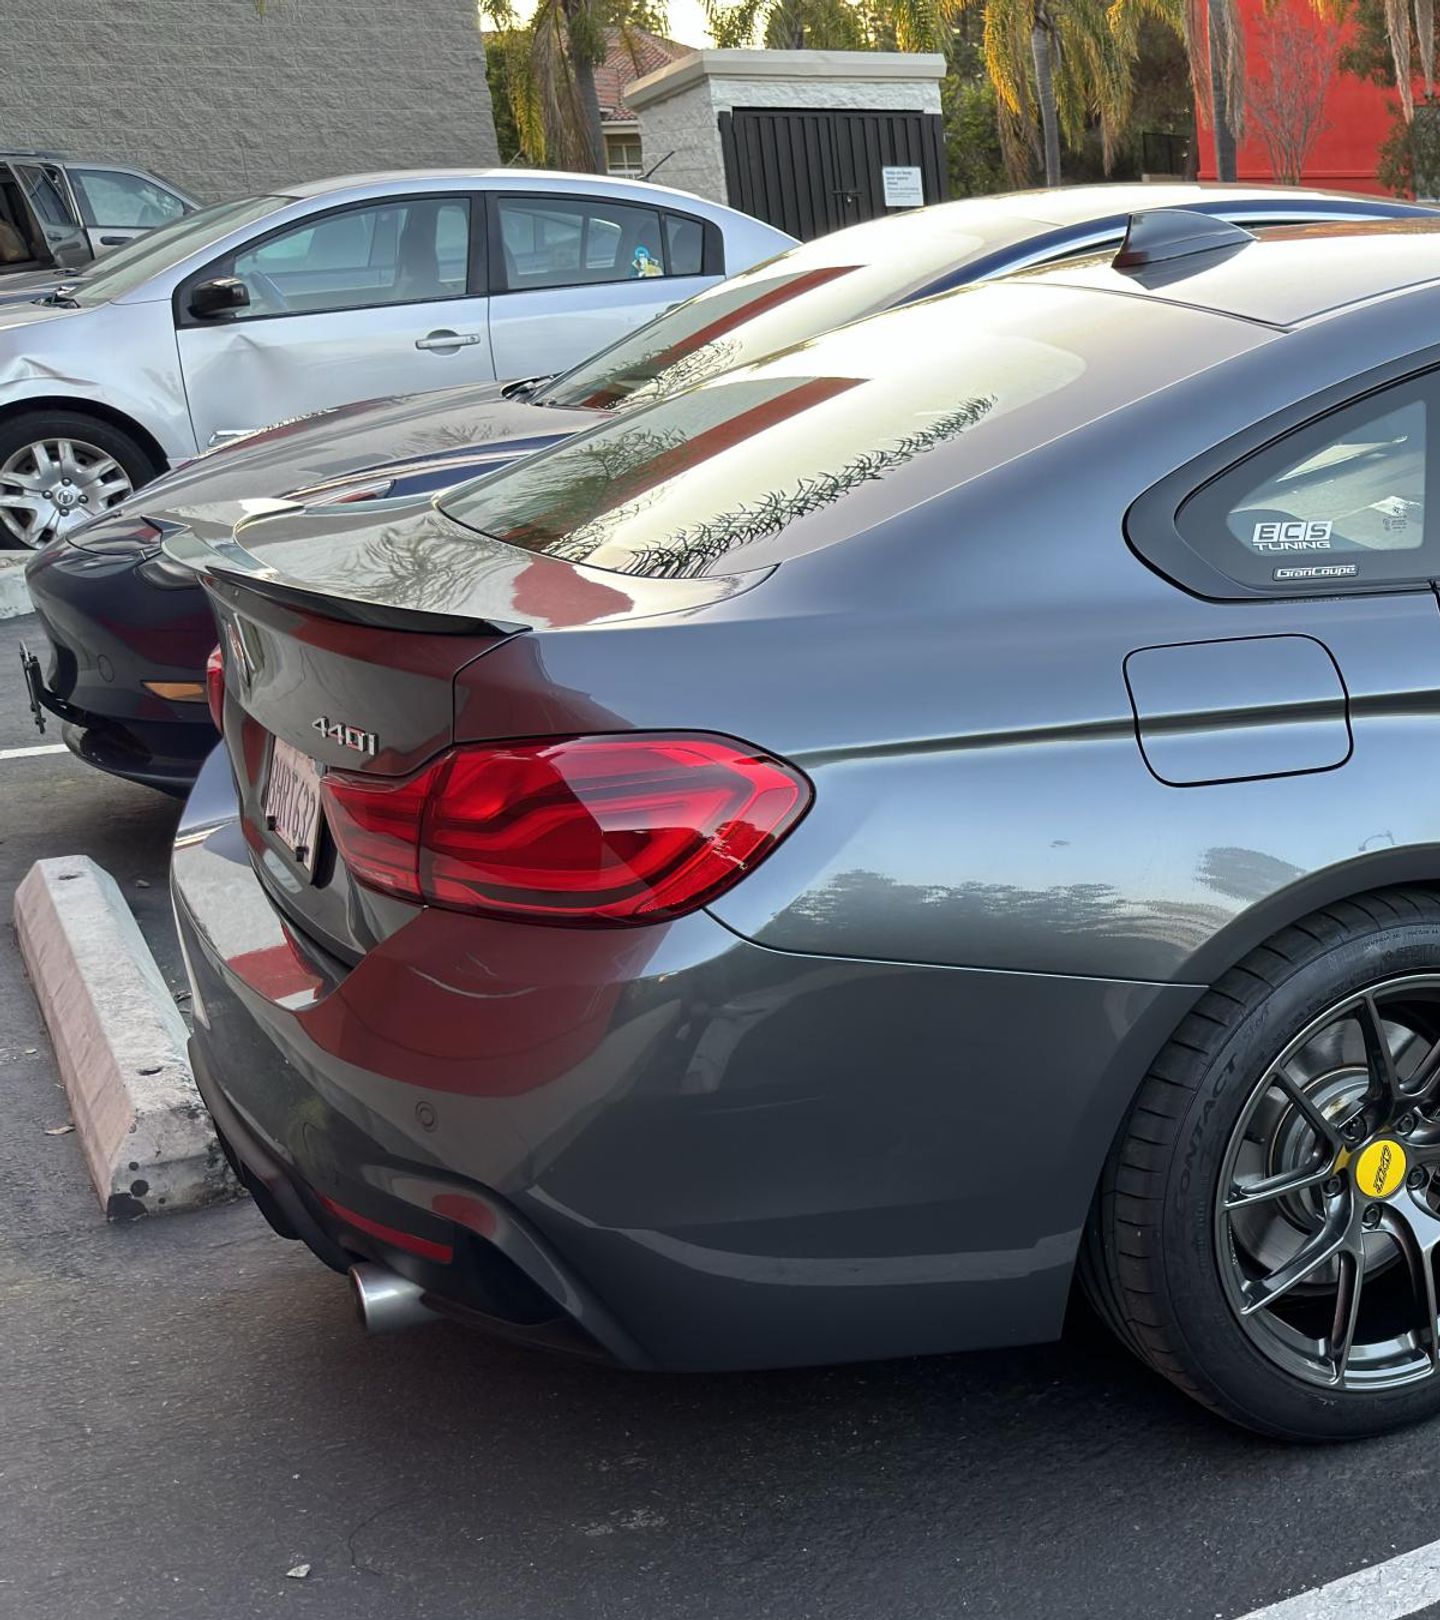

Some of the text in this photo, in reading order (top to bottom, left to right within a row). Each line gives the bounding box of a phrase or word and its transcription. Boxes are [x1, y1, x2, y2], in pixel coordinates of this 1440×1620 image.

[1254, 521, 1333, 542] ECS
[1253, 541, 1331, 551] TUNING
[312, 716, 377, 756] 440i
